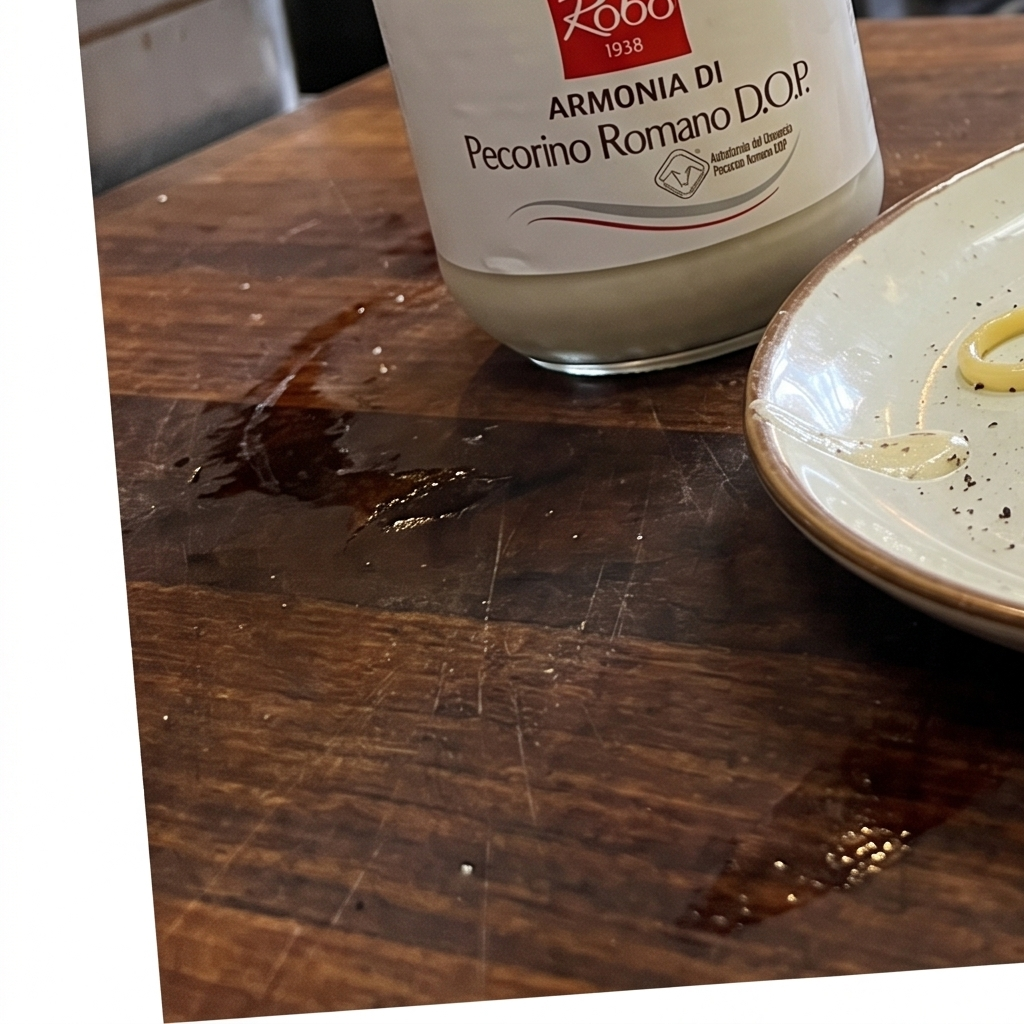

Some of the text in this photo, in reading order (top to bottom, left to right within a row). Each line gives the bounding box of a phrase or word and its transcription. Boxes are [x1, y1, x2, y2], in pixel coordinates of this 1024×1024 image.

[605, 37, 644, 58] 1938
[464, 60, 810, 171] Pecorino Romano D.O.P.
[549, 60, 723, 120] ARMONIA DI
